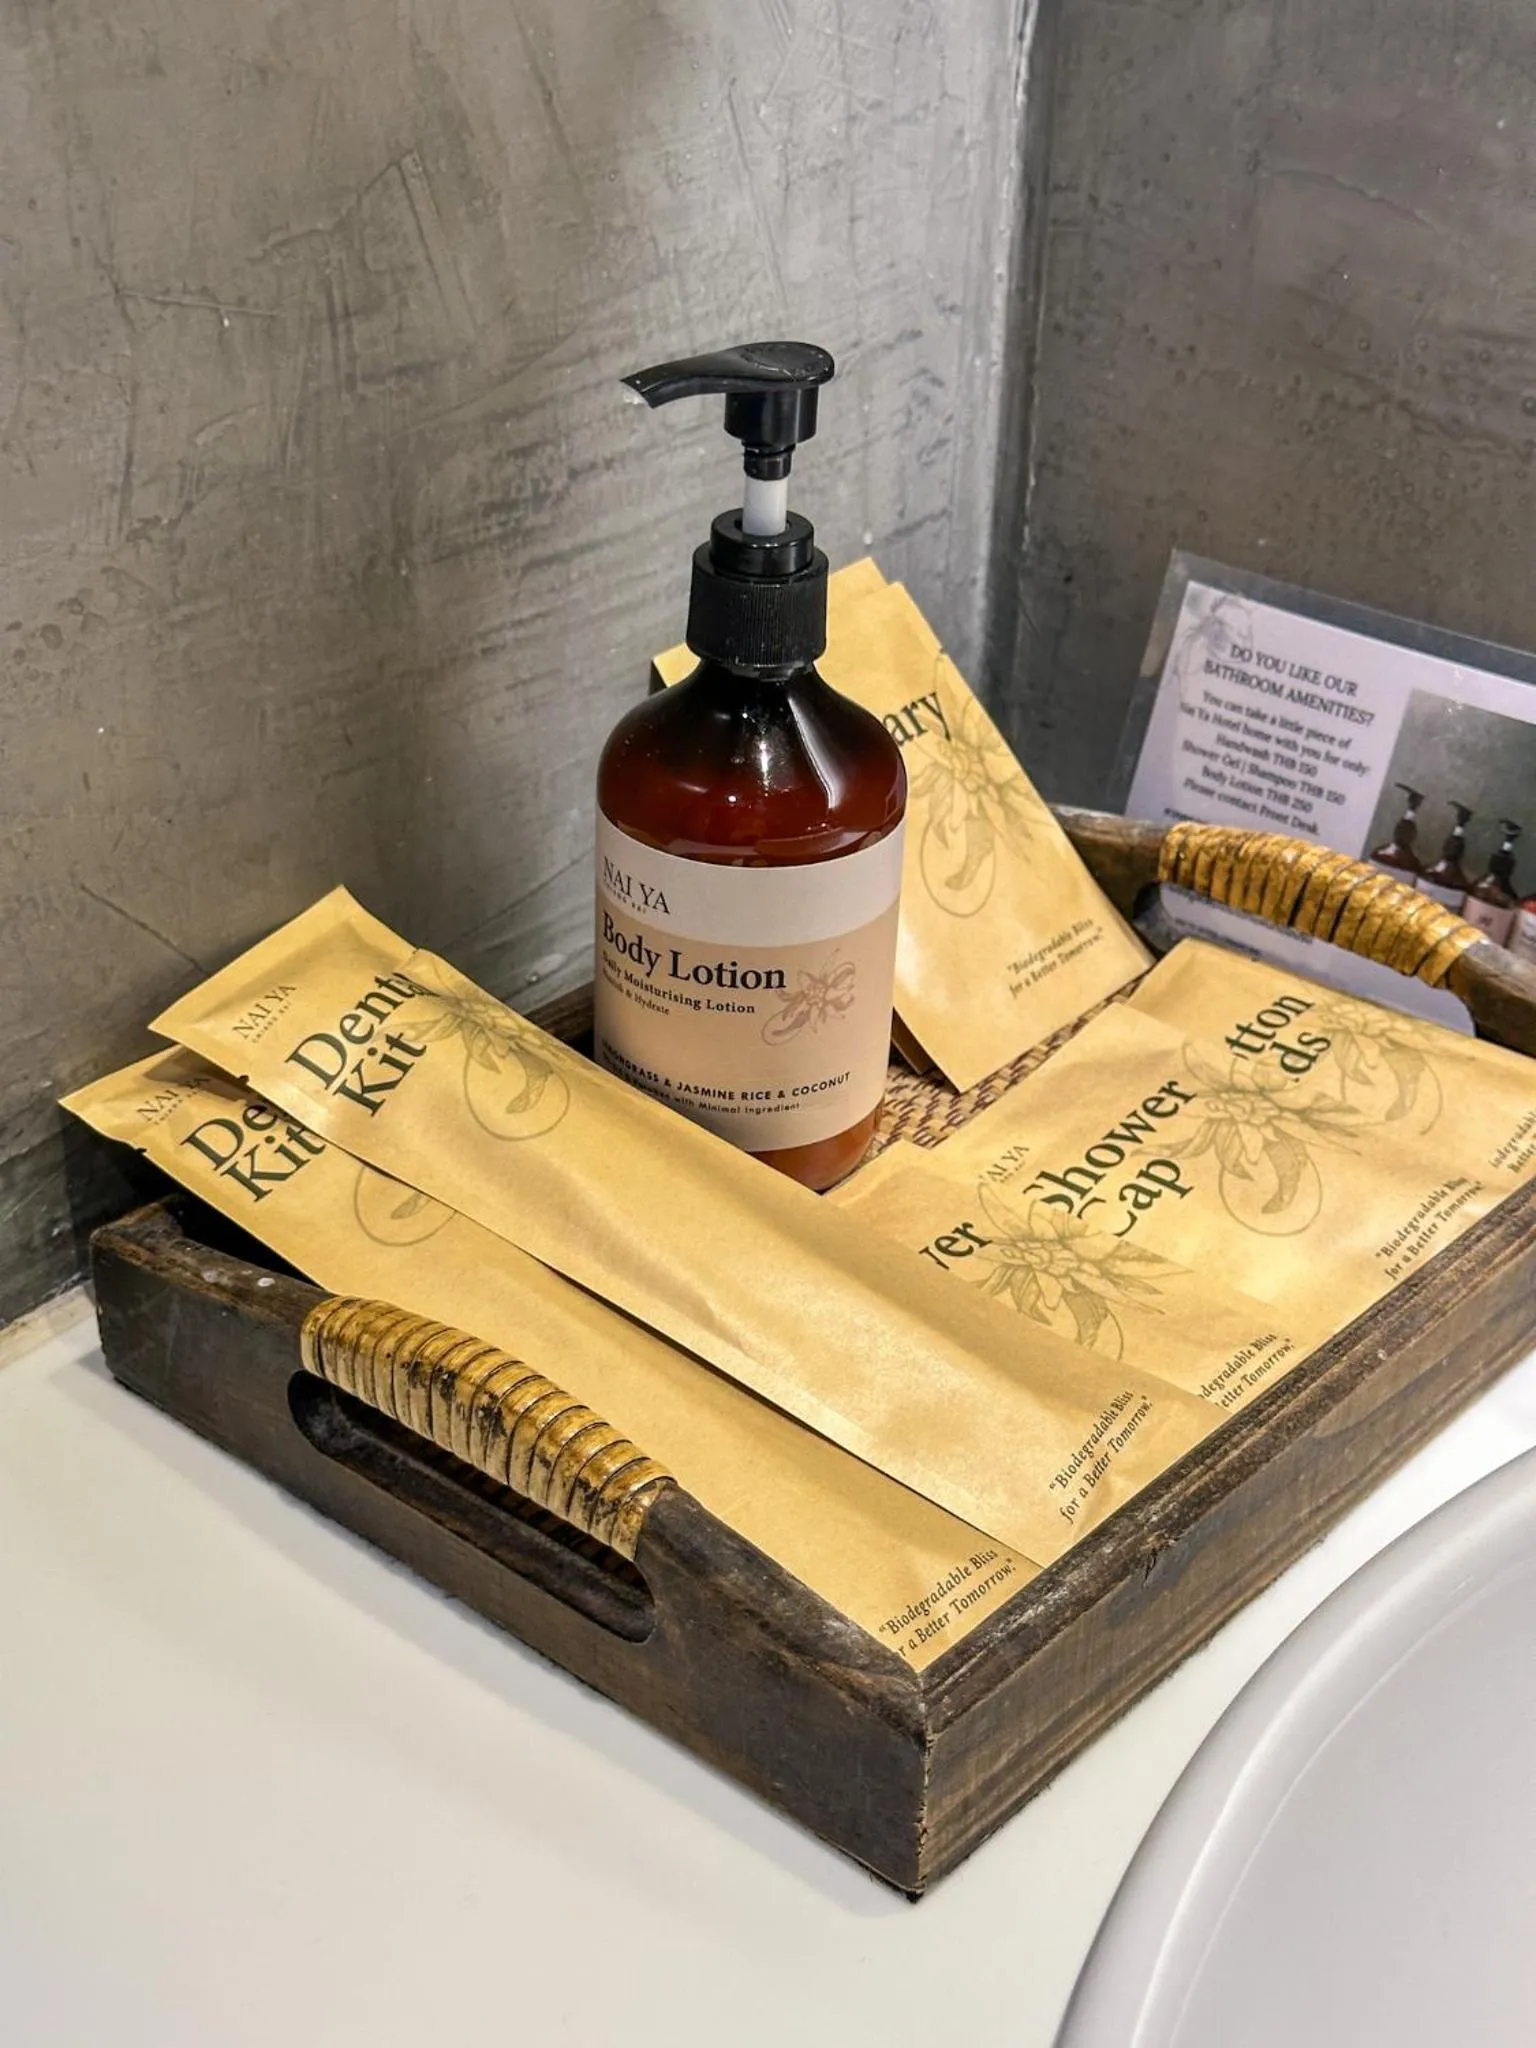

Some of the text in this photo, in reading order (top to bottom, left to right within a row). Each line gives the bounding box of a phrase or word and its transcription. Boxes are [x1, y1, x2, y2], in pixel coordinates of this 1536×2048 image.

[1204, 660, 1375, 726] BATHROOM AMENITIES?
[1230, 645, 1358, 697] DO YOU LIKE OUR
[1224, 699, 1243, 714] can
[1245, 704, 1268, 722] take
[1270, 714, 1276, 725] a
[1305, 727, 1336, 746] piece
[1338, 738, 1353, 750] of
[1243, 722, 1272, 742] home
[1275, 734, 1299, 752] with
[1300, 746, 1321, 762] you
[1248, 764, 1297, 790] Shampoo
[604, 856, 632, 897] NAI
[639, 882, 670, 915] YA
[603, 910, 662, 977] Body
[669, 950, 787, 990] Lotion
[232, 1003, 271, 1039] NAI
[264, 984, 297, 1003] YA
[624, 969, 702, 1010] Moisturising
[706, 998, 755, 1013] Lotion
[1225, 995, 1316, 1060] tton
[332, 1033, 427, 1117] Kit
[1269, 1032, 1331, 1081] ds
[677, 1081, 735, 1101] JASMINE
[741, 1090, 771, 1100] RICE
[778, 1090, 786, 1099] &
[792, 1071, 851, 1097] COCONUT
[699, 1101, 740, 1114] Minimal
[180, 1105, 278, 1171] De
[220, 1126, 326, 1202] Kit
[1112, 1390, 1134, 1413] Bliss
[1215, 1383, 1245, 1408] etter
[1059, 1500, 1081, 1525] for
[1080, 1487, 1088, 1499] a
[1087, 1452, 1112, 1488] Better
[970, 1549, 998, 1570] Bliss
[908, 1639, 918, 1651] a
[917, 1613, 949, 1643] Better
